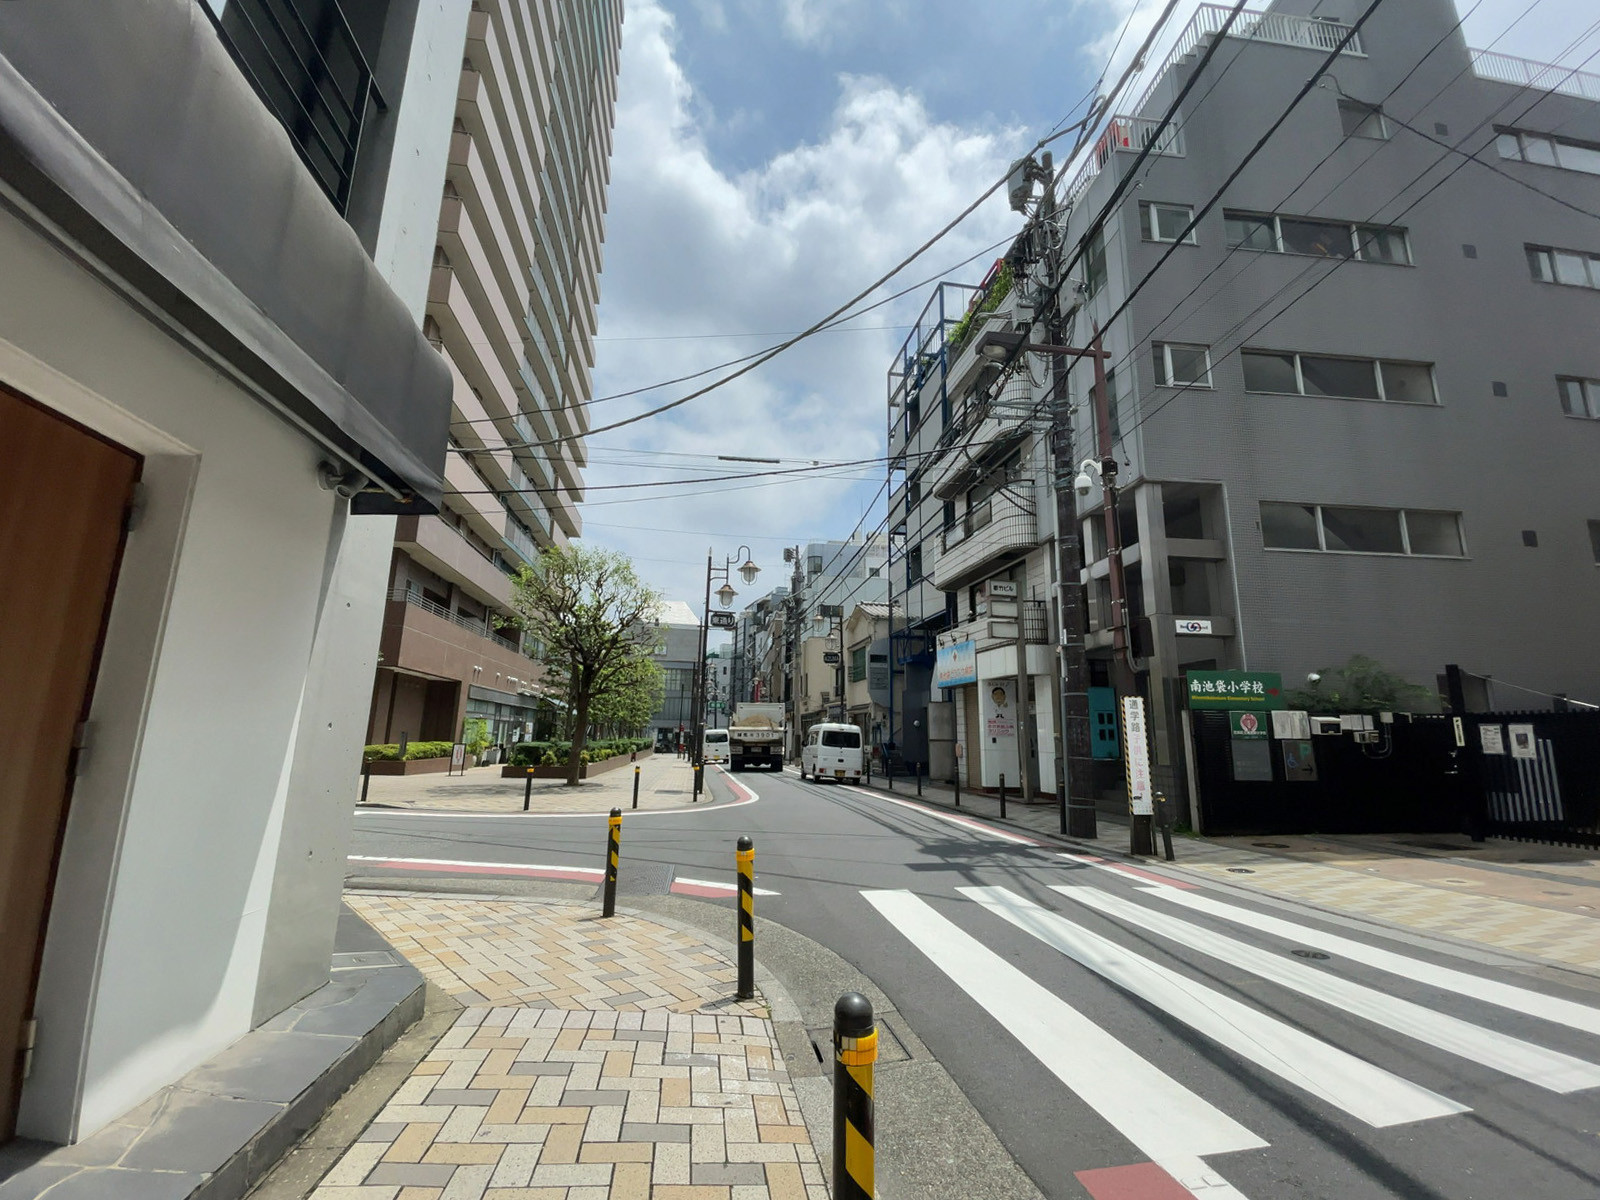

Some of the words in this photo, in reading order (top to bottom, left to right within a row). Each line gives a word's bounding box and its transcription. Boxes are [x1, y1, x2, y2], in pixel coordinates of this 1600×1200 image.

[1190, 679, 1264, 694] 南池袋小学校
